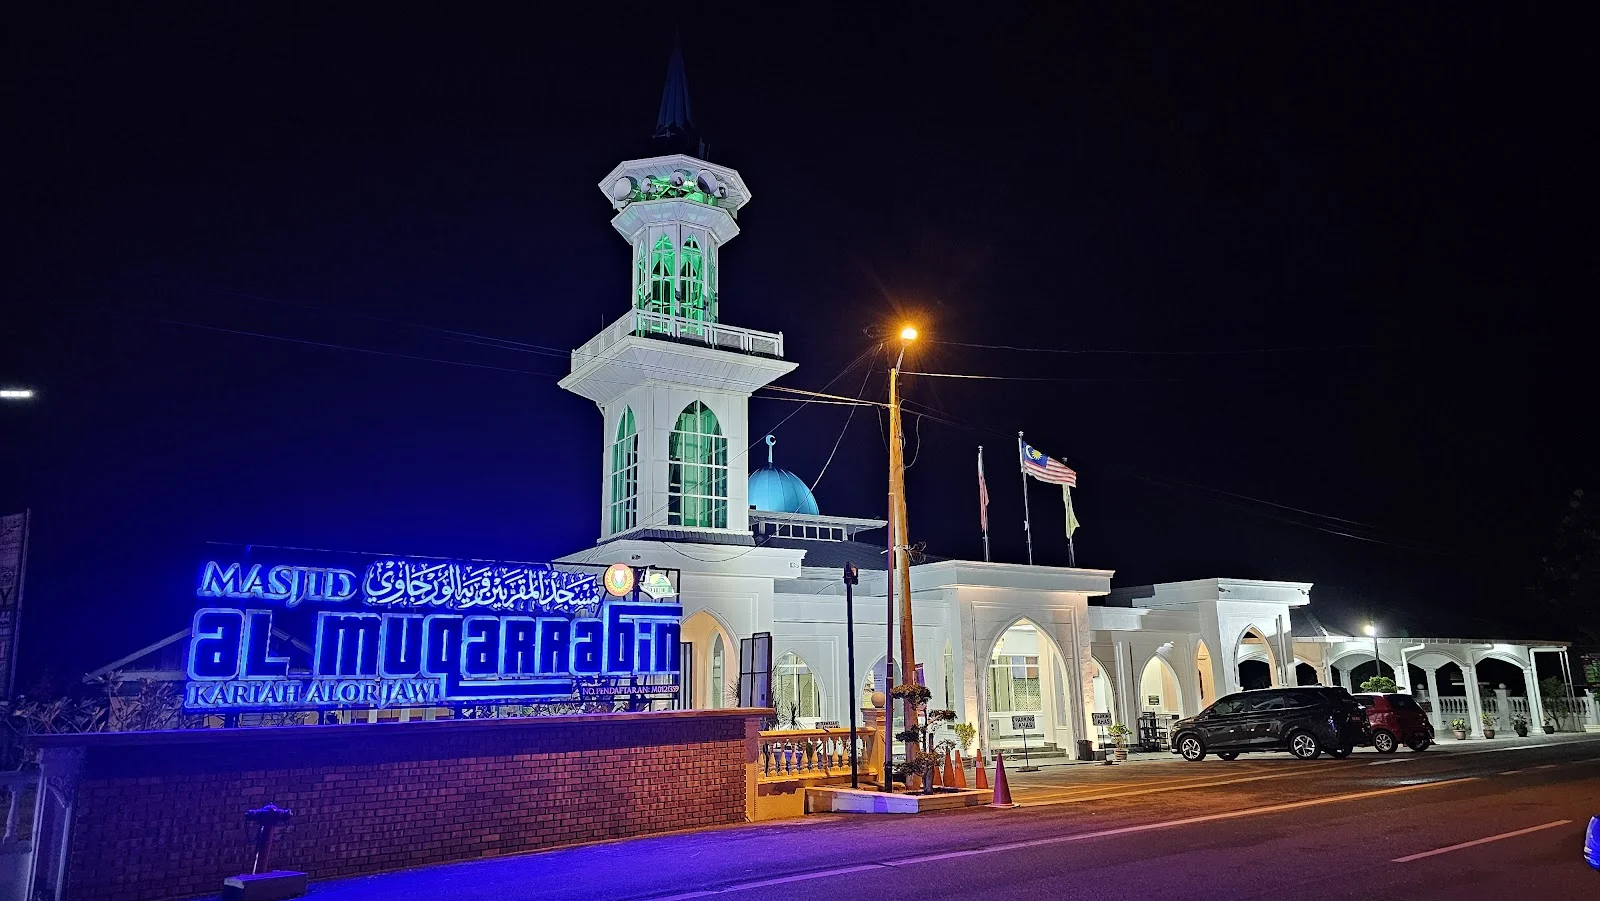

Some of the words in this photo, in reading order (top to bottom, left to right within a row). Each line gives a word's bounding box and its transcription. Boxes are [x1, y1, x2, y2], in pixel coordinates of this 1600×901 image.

[197, 561, 357, 607] MASJID
[185, 680, 303, 709] KARIAH
[582, 687, 596, 695] NO.
[596, 686, 651, 695] PENDAFTARAN:
